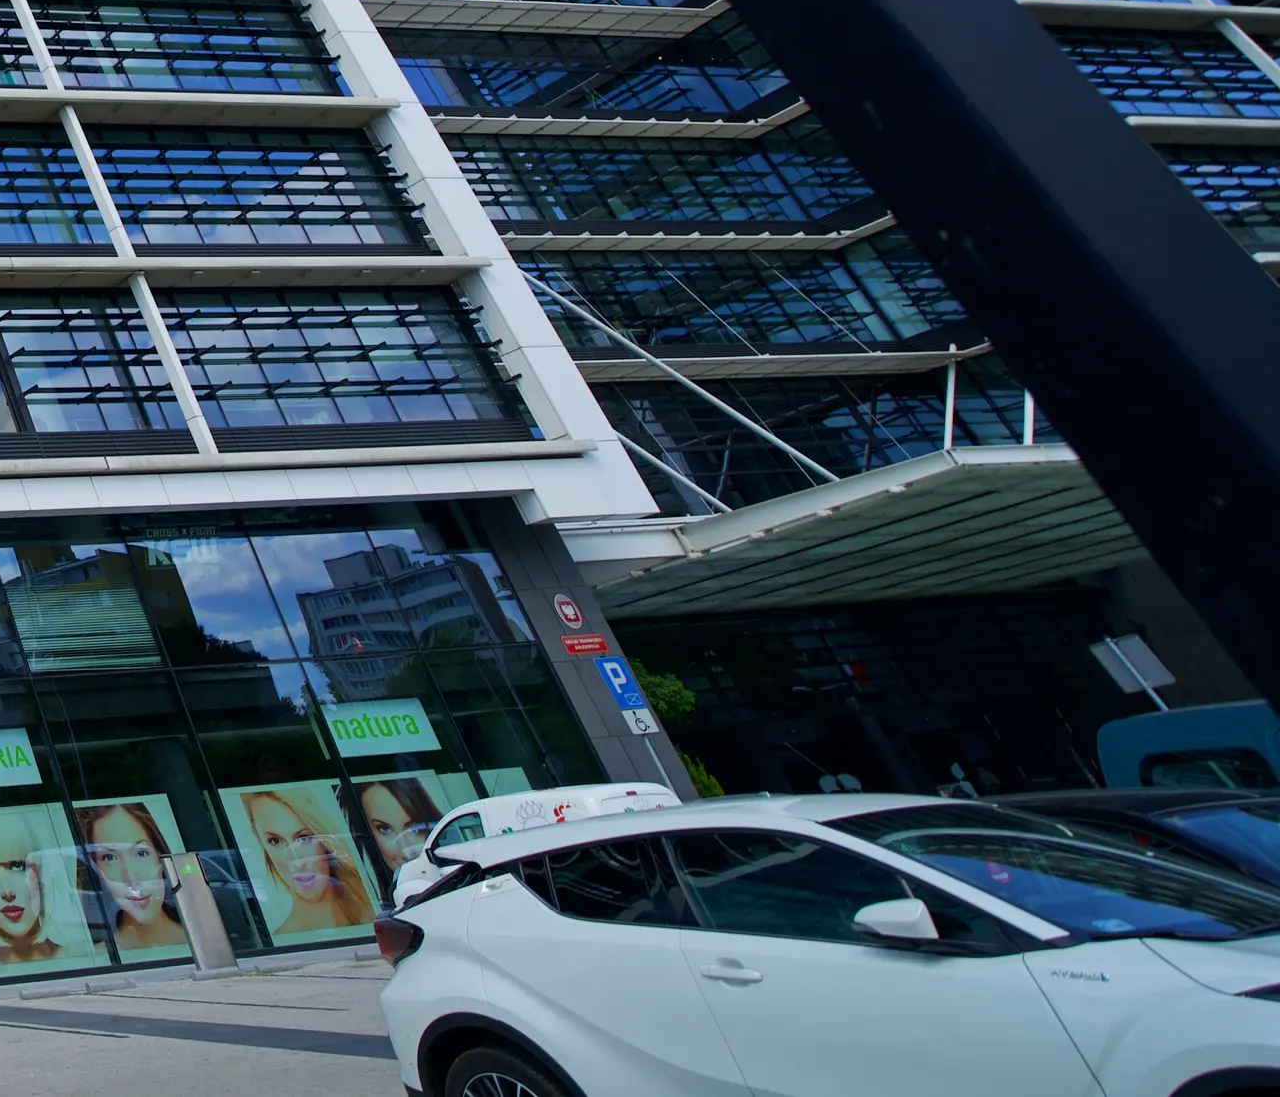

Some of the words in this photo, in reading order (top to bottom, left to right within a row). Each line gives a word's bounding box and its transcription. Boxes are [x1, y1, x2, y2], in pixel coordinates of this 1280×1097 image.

[145, 528, 178, 538] CROSS
[189, 526, 217, 536] FIGHT
[602, 662, 627, 693] P
[332, 713, 419, 740] natura
